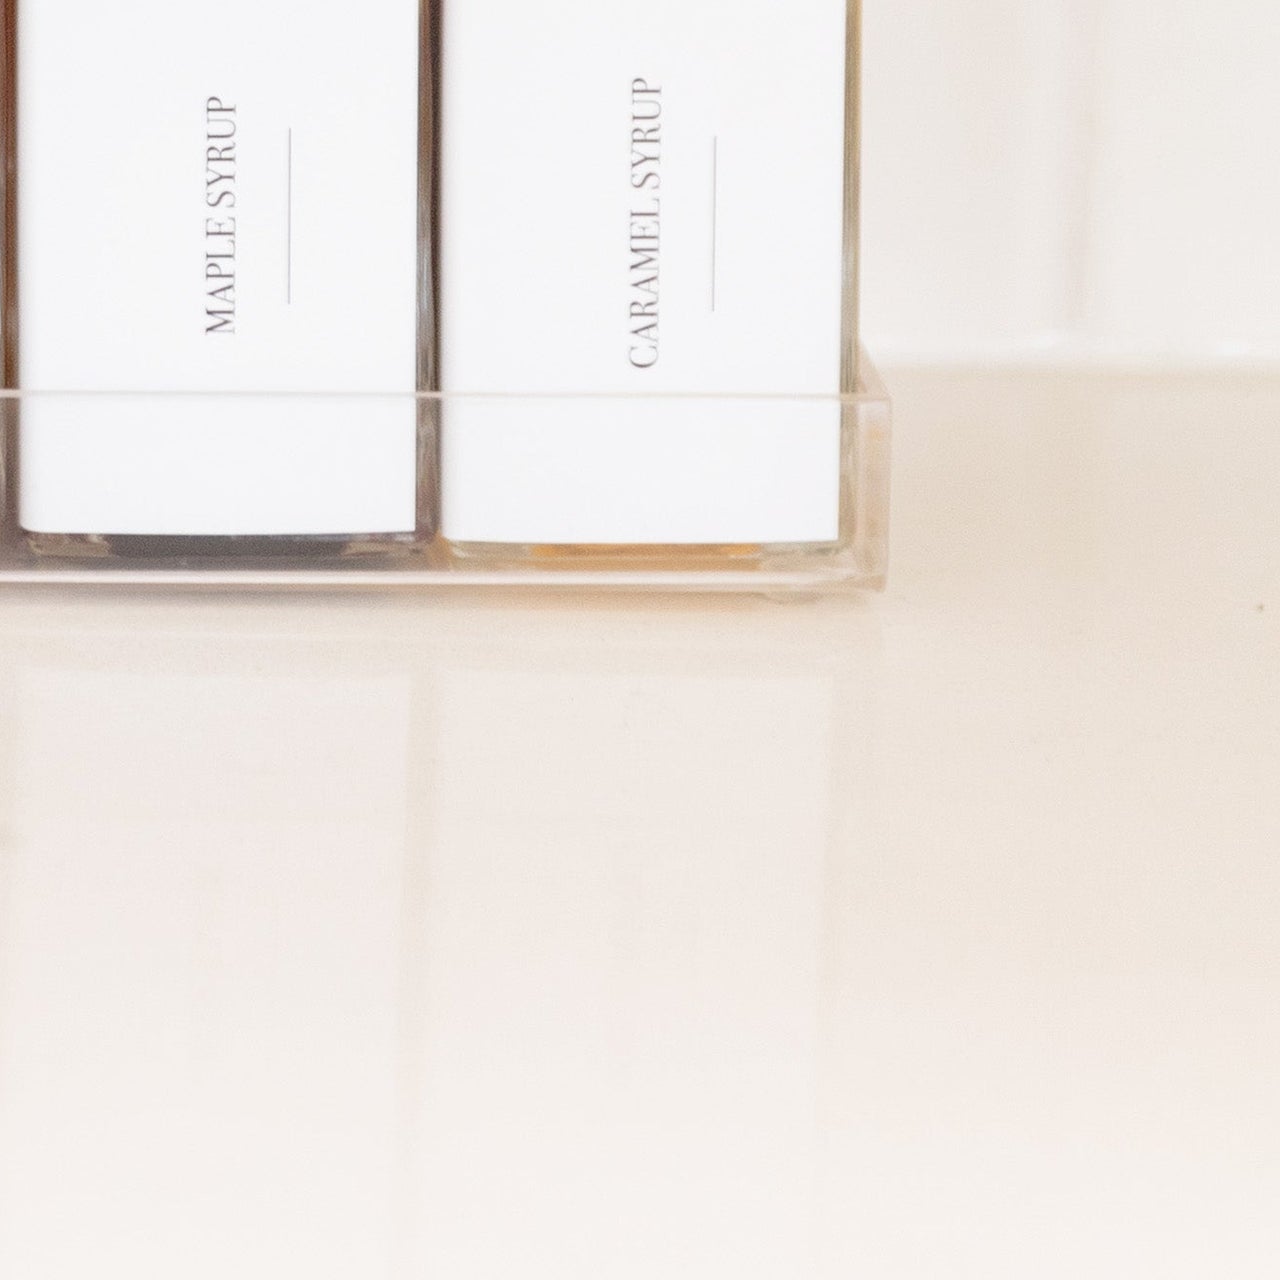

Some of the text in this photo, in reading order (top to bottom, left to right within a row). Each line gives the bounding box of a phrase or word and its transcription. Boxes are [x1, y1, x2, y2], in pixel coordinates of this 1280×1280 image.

[204, 95, 237, 335] MAPLE SYRUP
[628, 76, 662, 370] CARAMEL SYRUP
